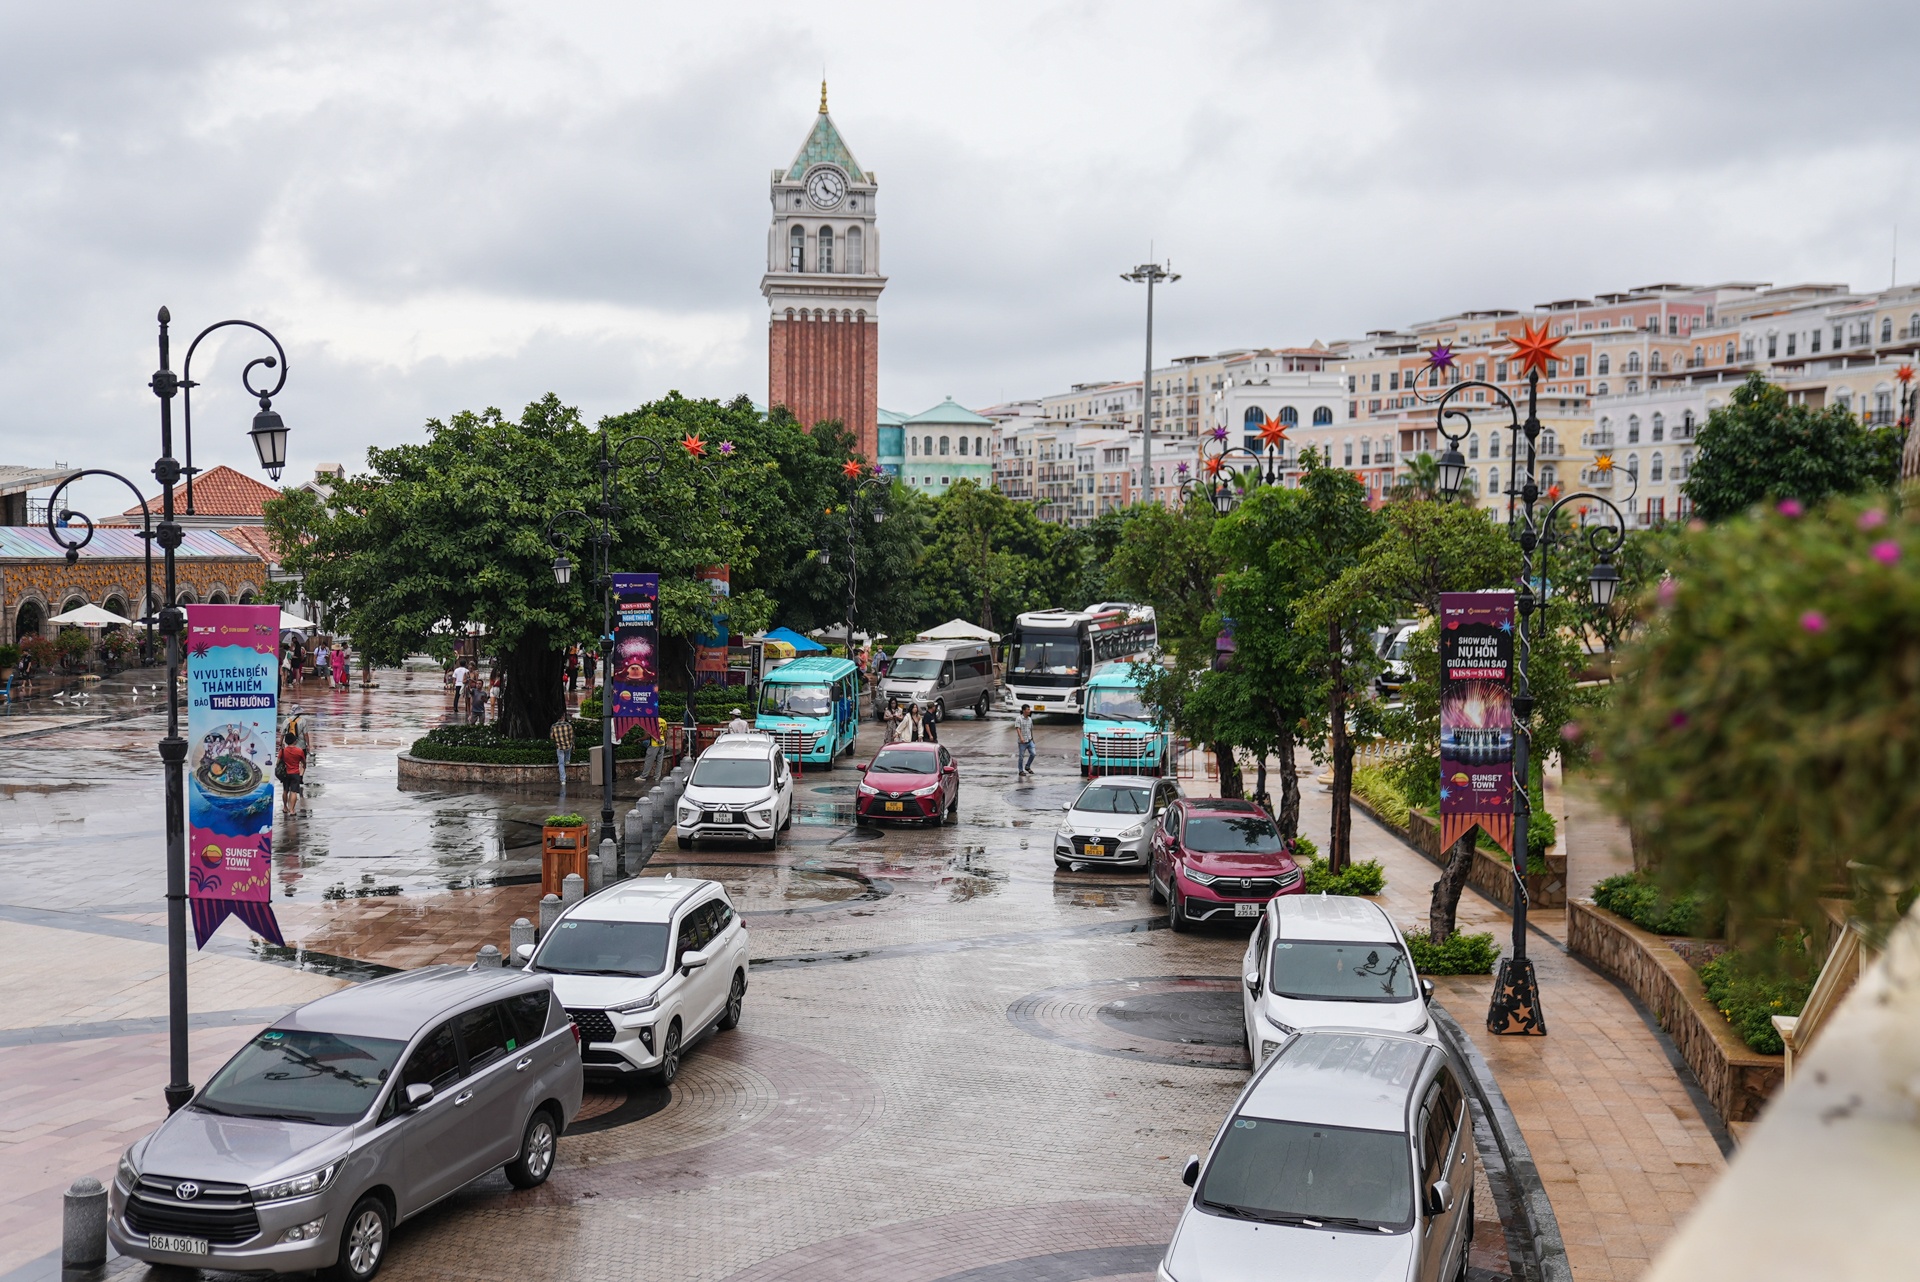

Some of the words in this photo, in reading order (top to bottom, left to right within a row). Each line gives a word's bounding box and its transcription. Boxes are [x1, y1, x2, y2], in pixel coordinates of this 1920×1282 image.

[1458, 637, 1480, 645] SHOW
[1480, 635, 1498, 646] DIỄN
[1458, 646, 1473, 659] NỤ
[1475, 645, 1498, 658] HÔN
[1447, 658, 1466, 668] GIỮA
[1467, 658, 1490, 668] NGÀN
[1491, 660, 1507, 668] SAO
[193, 670, 203, 680] VI
[205, 669, 218, 679] VU
[220, 666, 244, 678] TRÊN
[246, 664, 268, 677] BIỂN
[1478, 669, 1503, 678] STARS
[202, 679, 233, 693] THÁM
[236, 677, 262, 691] HIỂM
[213, 696, 238, 708] THIÊN
[240, 695, 270, 708] ĐƯỜNG
[225, 848, 258, 858] SUNSET
[226, 857, 249, 867] TOWN
